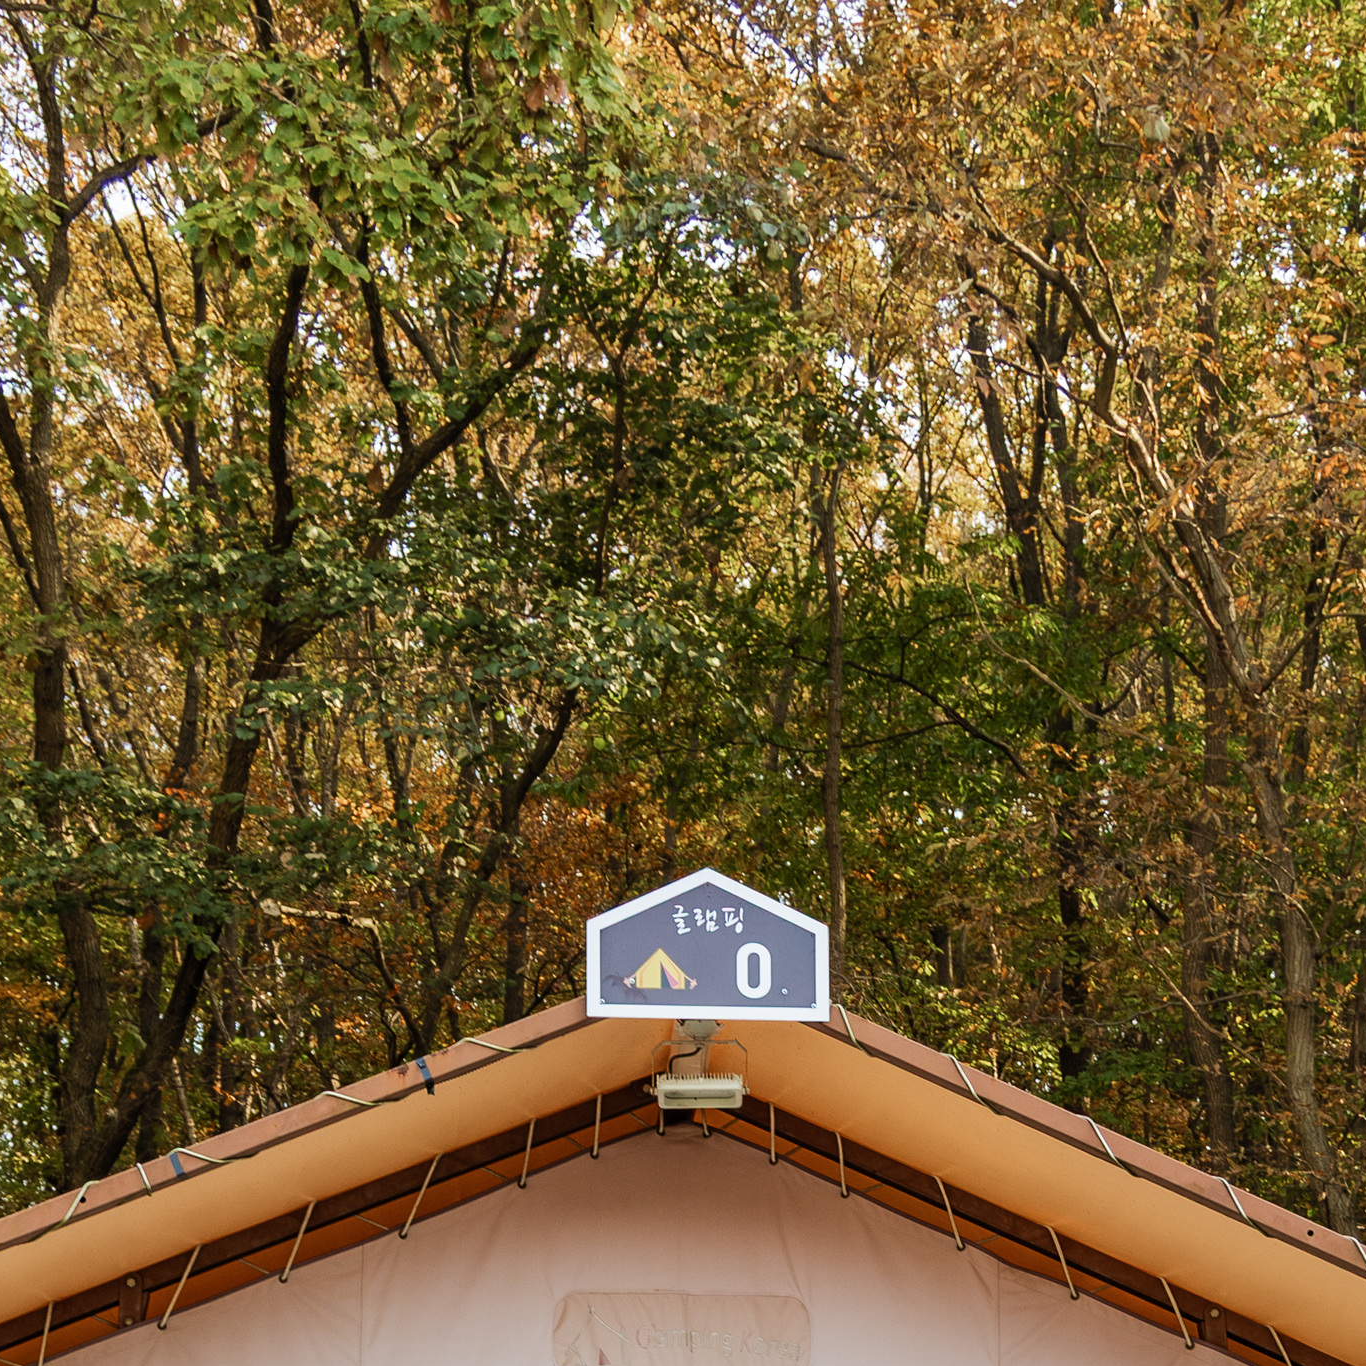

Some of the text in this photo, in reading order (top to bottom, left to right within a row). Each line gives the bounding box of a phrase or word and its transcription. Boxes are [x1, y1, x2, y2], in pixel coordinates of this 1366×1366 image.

[672, 904, 744, 935] 글램핑
[736, 942, 772, 999] 0
[635, 1323, 802, 1362] Glamping Korea
